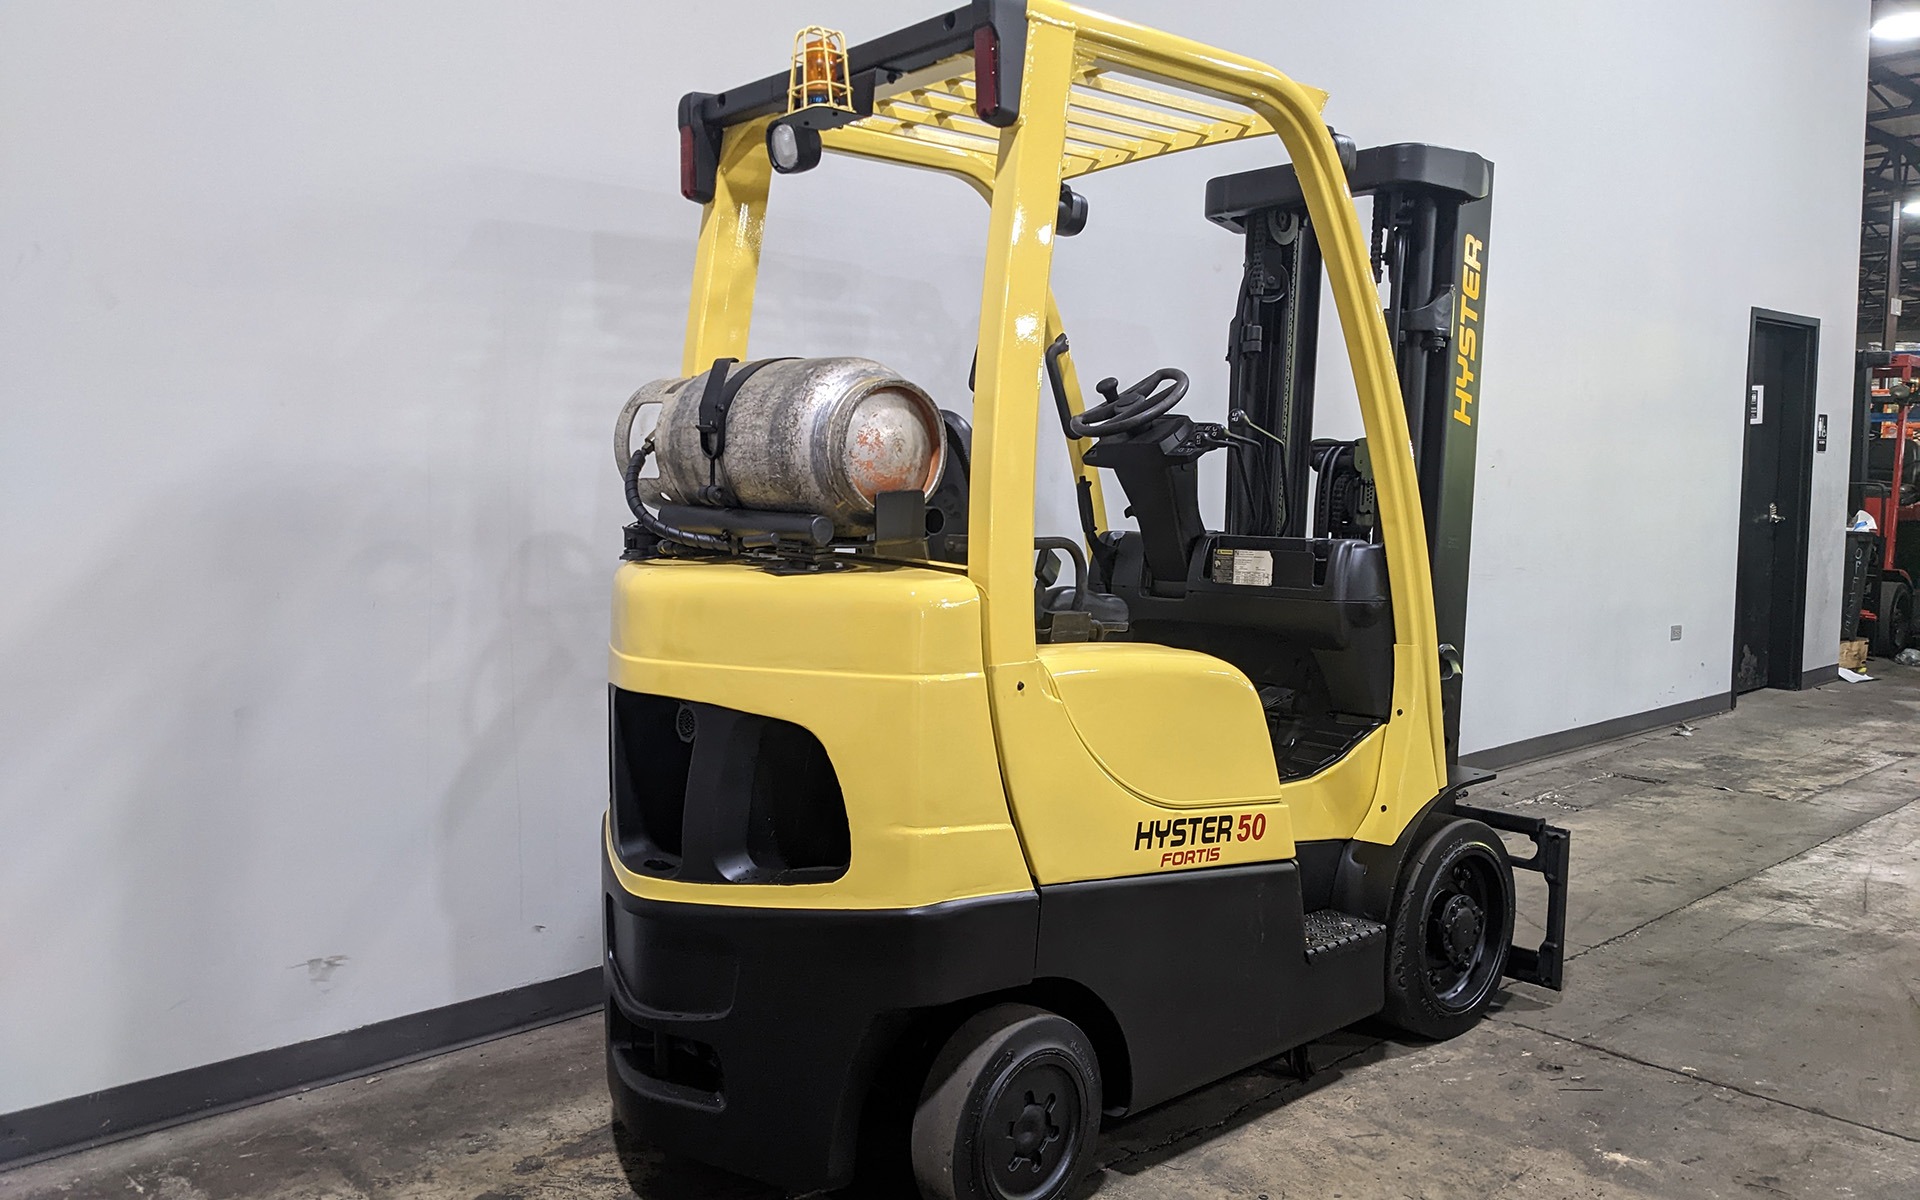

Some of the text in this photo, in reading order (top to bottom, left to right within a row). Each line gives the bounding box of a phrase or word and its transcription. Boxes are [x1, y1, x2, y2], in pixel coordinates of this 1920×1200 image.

[1453, 233, 1483, 426] HYSTER
[1134, 813, 1266, 850] HYSTER 50
[1160, 847, 1221, 868] FORTIS
